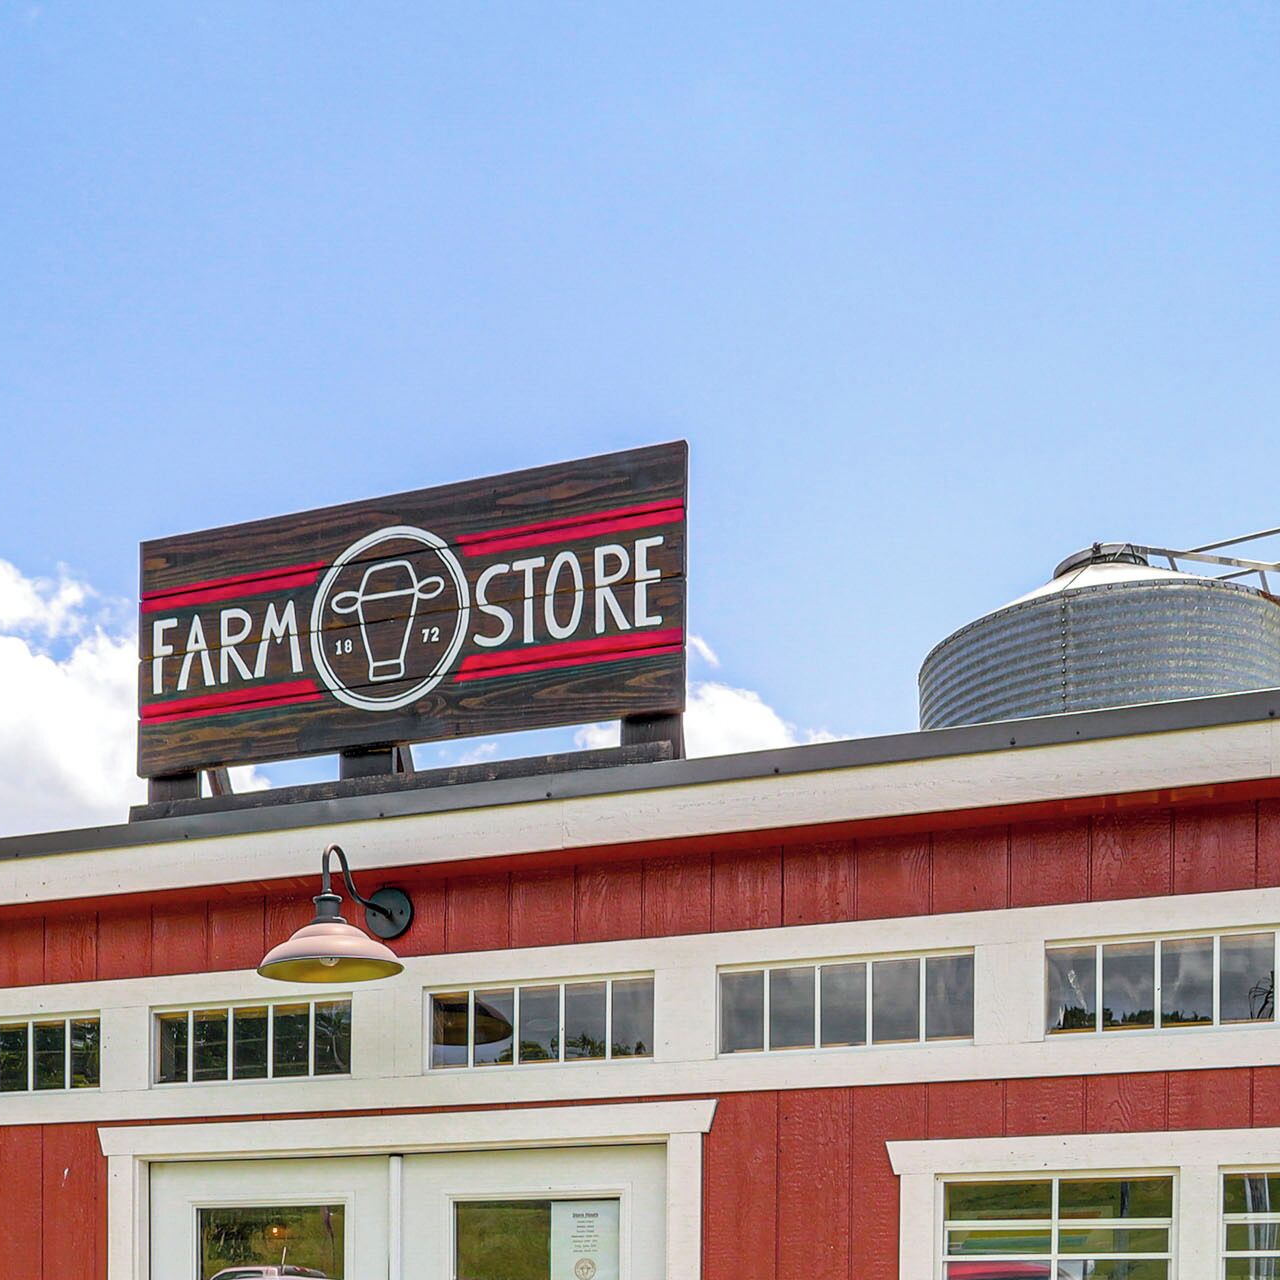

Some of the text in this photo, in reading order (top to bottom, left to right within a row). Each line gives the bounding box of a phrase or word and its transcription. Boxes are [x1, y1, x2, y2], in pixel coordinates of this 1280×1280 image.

[152, 534, 666, 696] FARM STORE
[334, 626, 441, 656] 18 72
